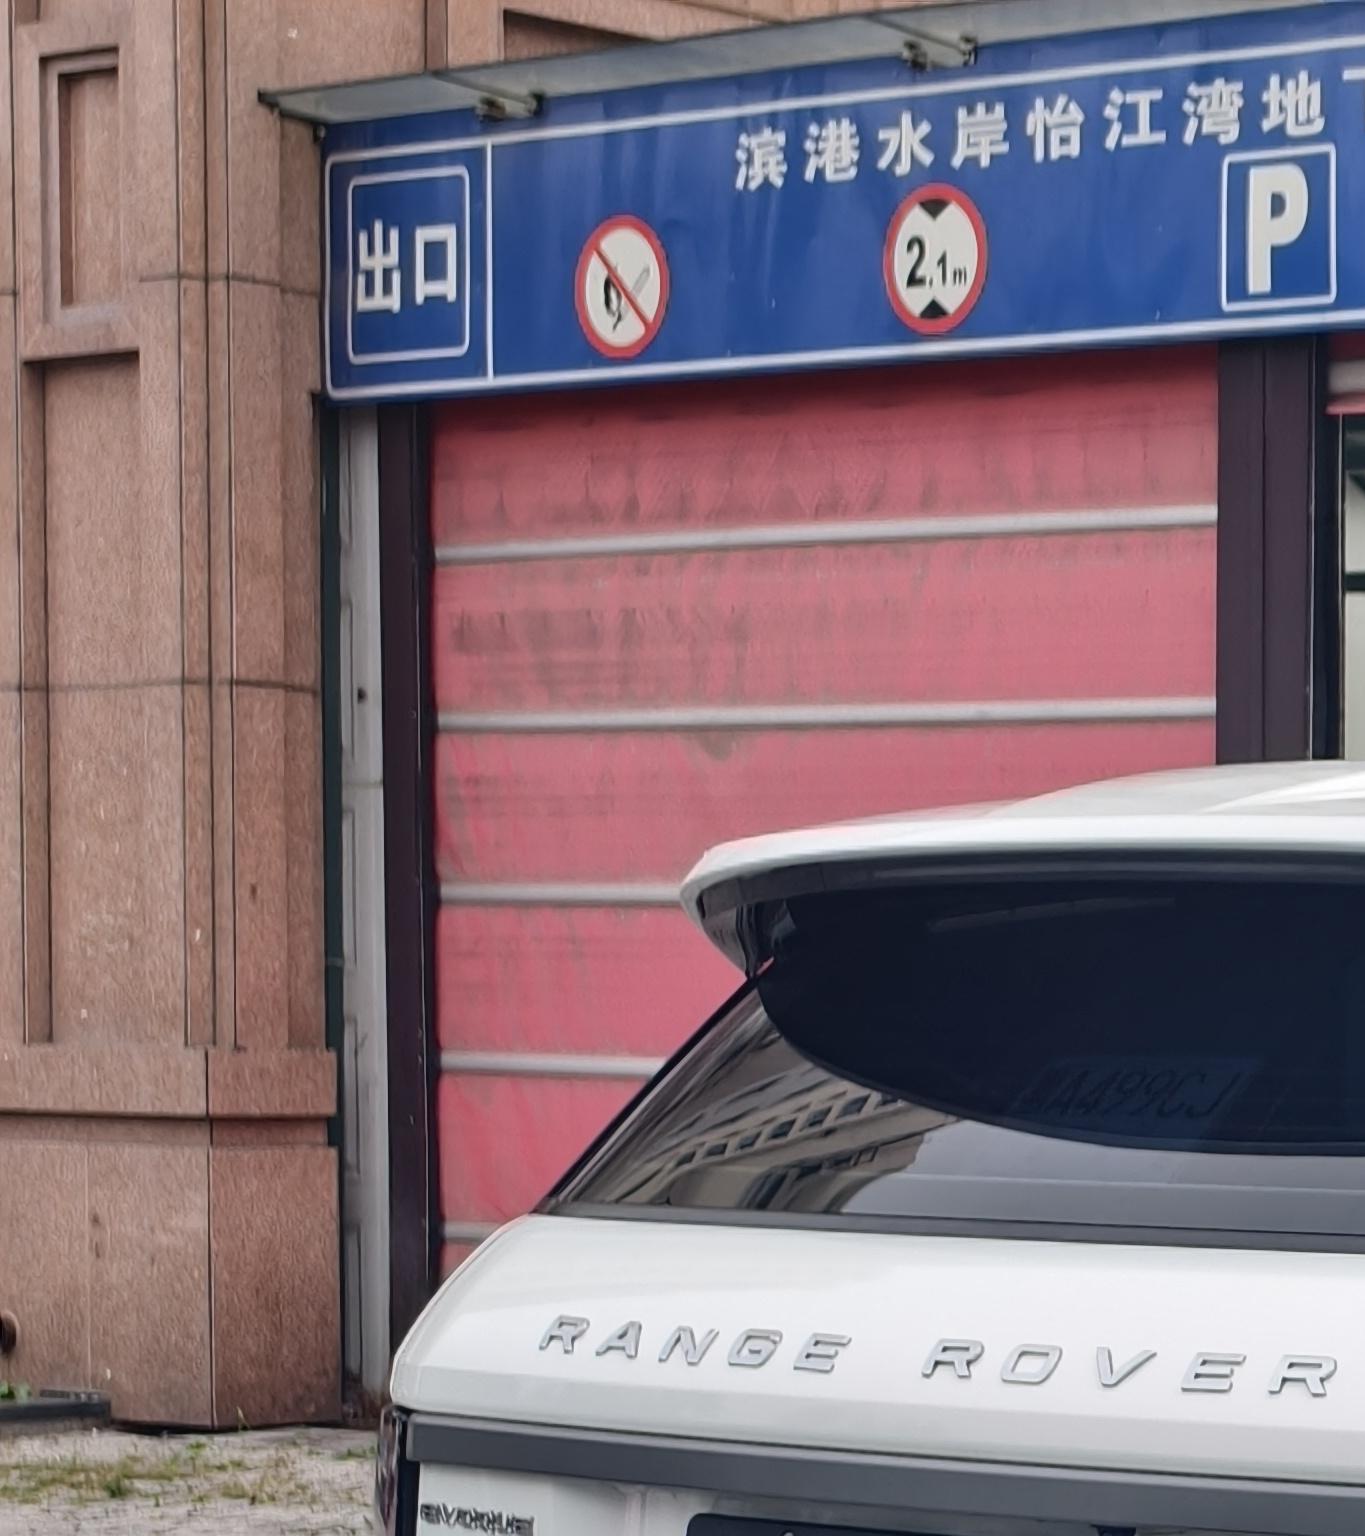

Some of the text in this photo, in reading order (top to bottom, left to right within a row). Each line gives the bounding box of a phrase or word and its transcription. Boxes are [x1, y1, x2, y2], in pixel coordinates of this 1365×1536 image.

[356, 219, 457, 313] 出口
[1246, 162, 1310, 295] P
[538, 1314, 1339, 1397] RANGE ROVER
